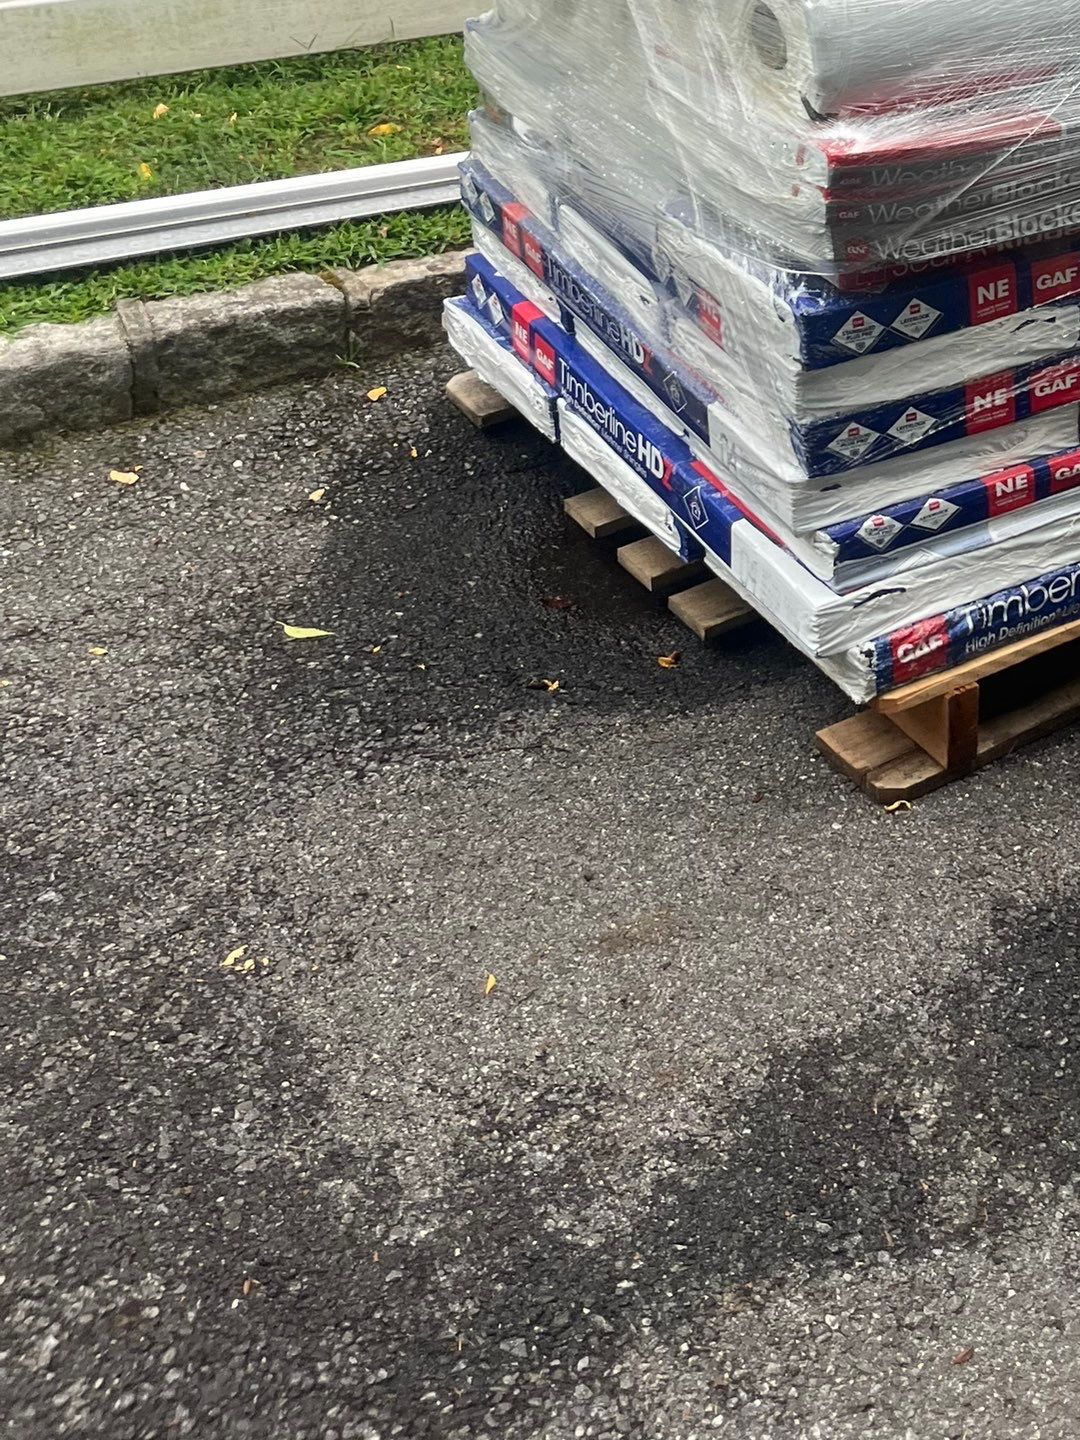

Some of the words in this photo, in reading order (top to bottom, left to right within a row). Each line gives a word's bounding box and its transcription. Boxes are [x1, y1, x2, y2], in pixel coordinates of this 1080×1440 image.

[977, 278, 1009, 304] NE
[1036, 267, 1078, 290] GAF
[515, 322, 528, 345] NE
[536, 348, 554, 371] GAF
[1034, 375, 1077, 397] GAF
[996, 473, 1028, 497] NE
[897, 633, 943, 663] GAF
[965, 632, 996, 655] High
[999, 613, 1055, 642] Definition
